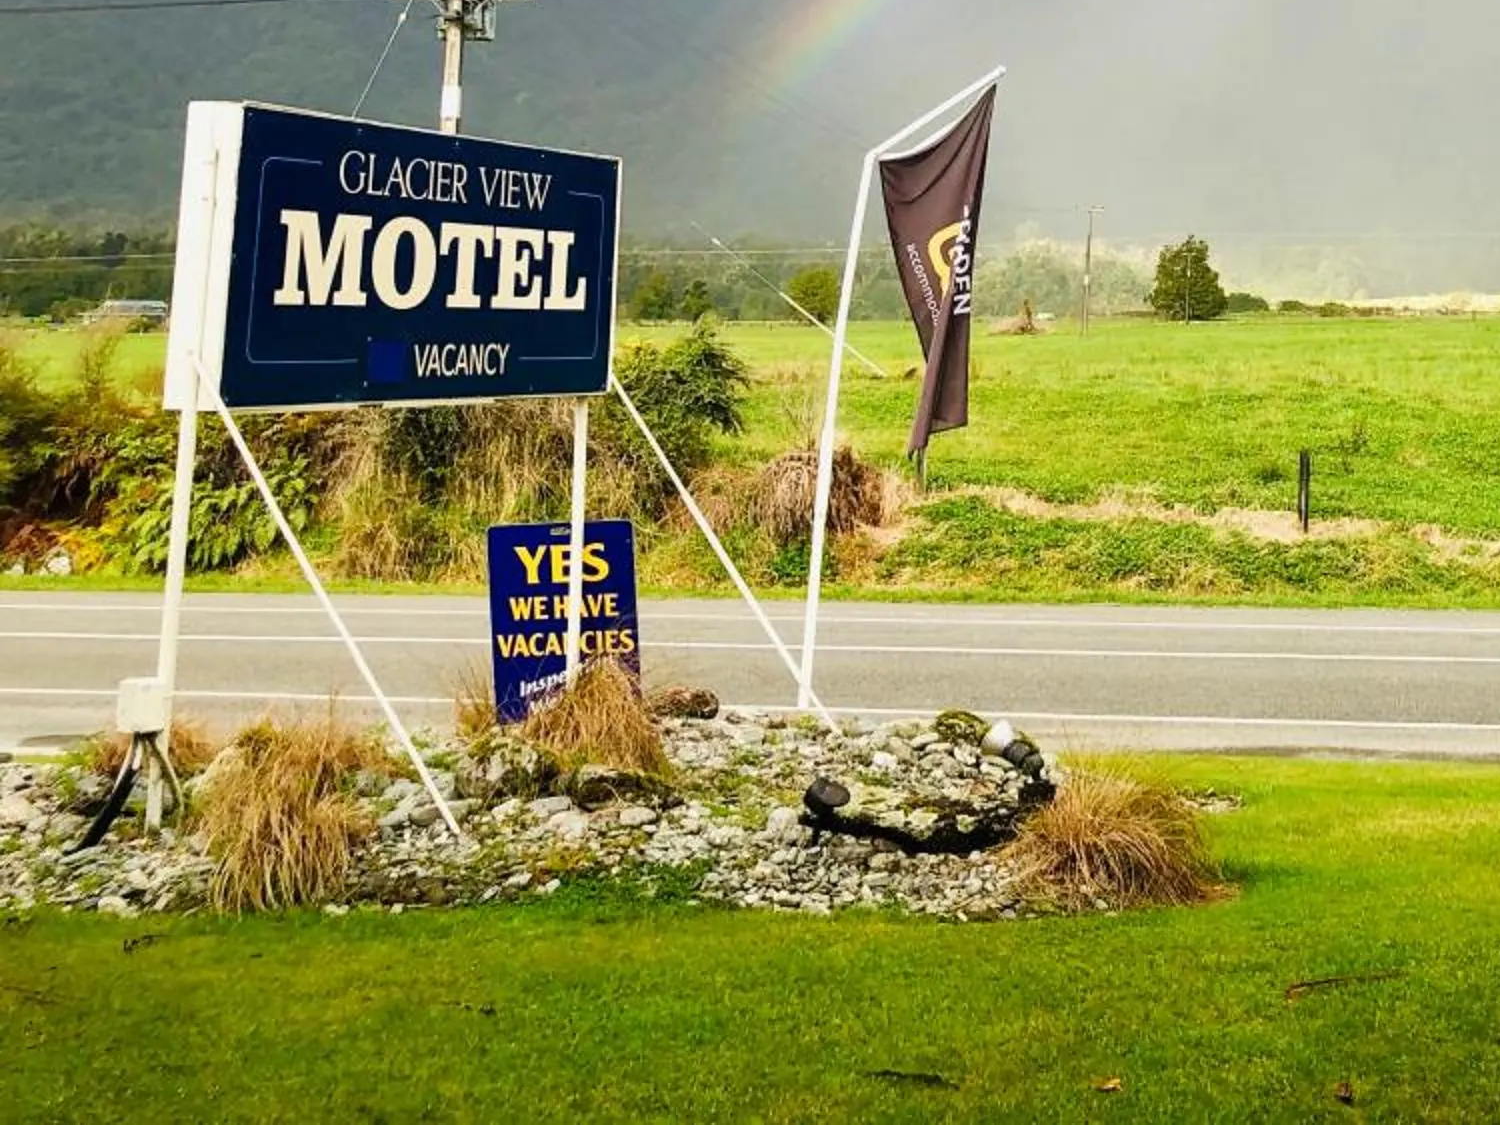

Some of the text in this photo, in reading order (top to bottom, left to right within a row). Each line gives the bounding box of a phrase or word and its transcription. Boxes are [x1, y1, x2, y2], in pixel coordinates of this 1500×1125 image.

[339, 150, 552, 211] GLACIER VIEW
[273, 209, 587, 311] MOTEL
[414, 343, 510, 378] VACANCY
[513, 542, 610, 584] YES
[509, 596, 549, 621] WE
